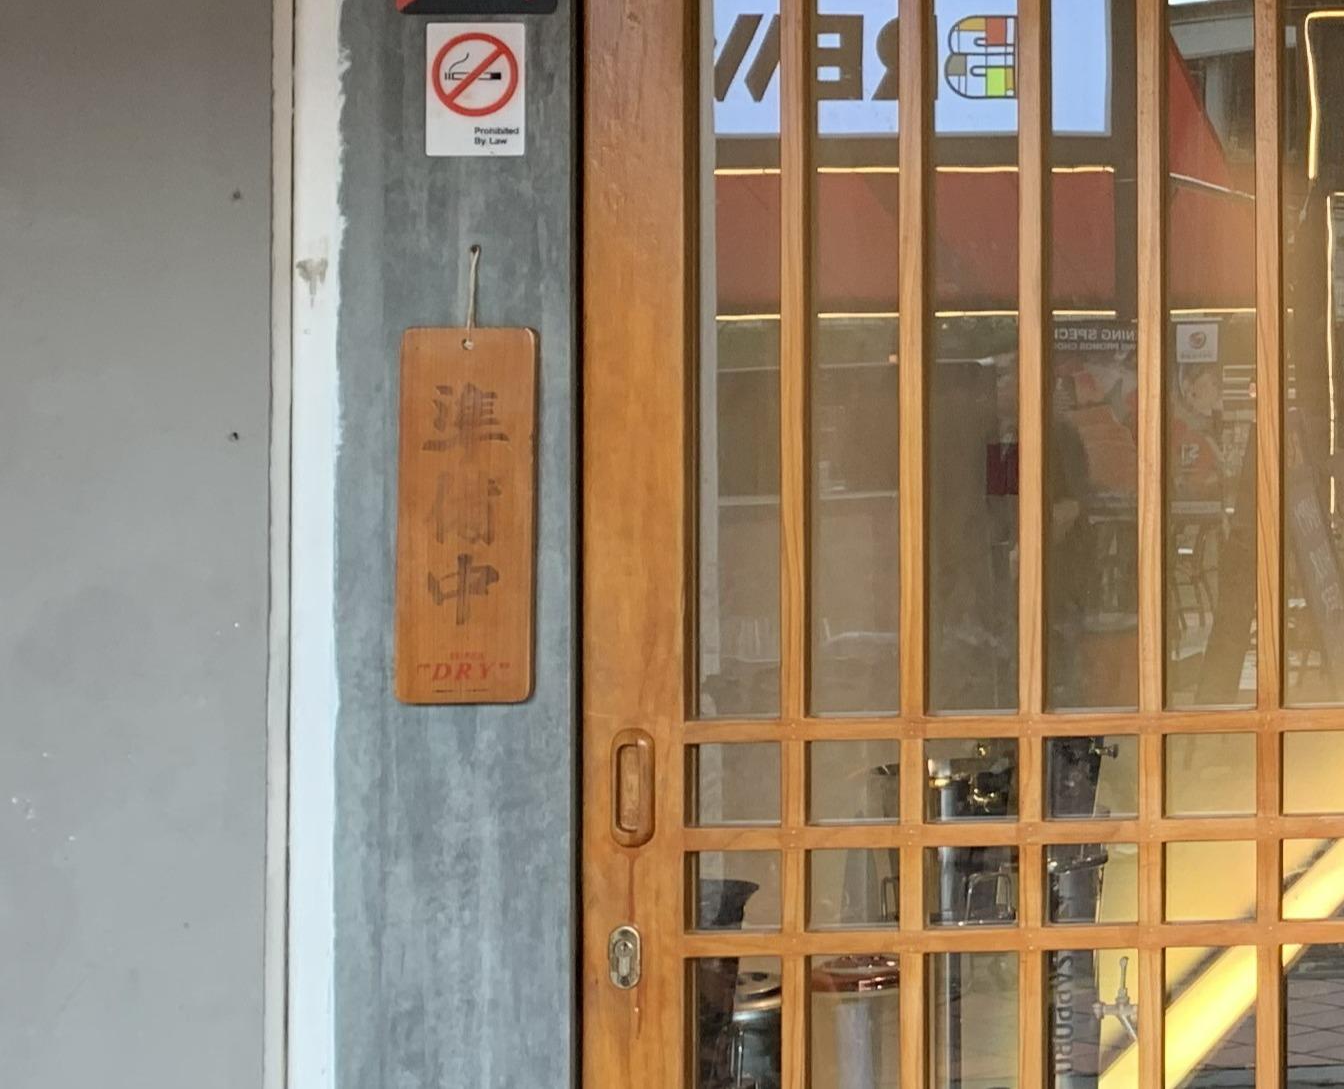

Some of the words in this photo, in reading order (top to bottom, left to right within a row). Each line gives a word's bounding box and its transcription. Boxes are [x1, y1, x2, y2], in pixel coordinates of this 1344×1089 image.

[474, 126, 520, 135] Prohibited
[474, 136, 486, 146] By
[489, 137, 507, 145] Law
